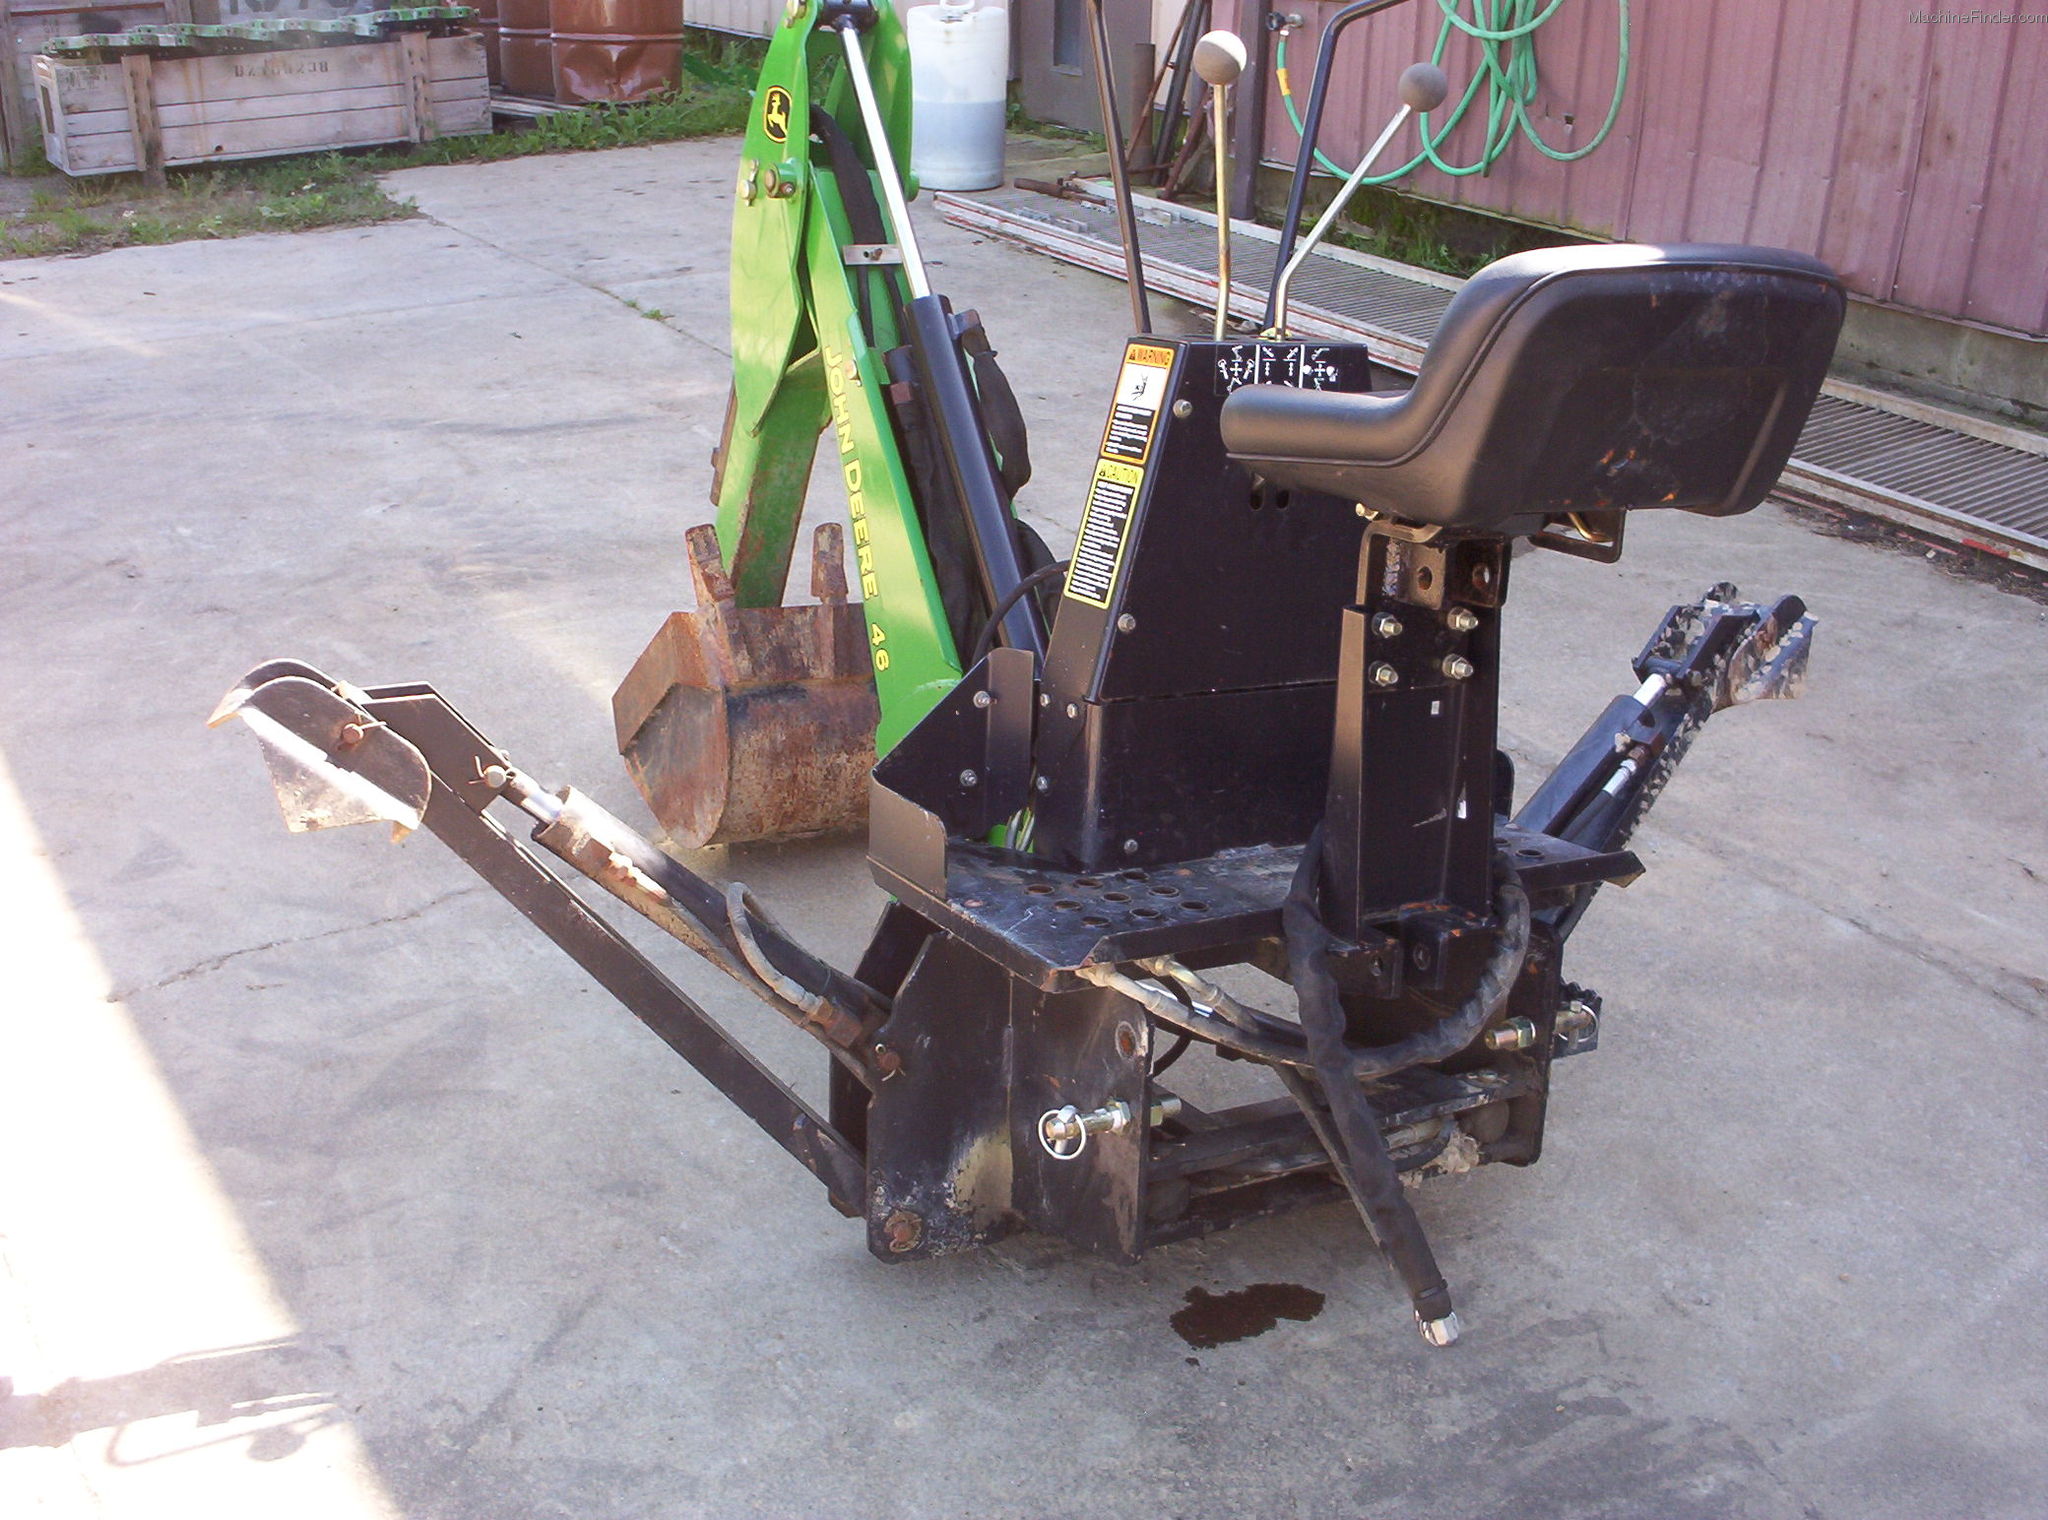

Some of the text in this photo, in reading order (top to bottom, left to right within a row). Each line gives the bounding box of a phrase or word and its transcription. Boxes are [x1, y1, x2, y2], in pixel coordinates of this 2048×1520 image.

[1136, 348, 1172, 366] WARNING
[1105, 464, 1139, 485] CAUTION
[824, 344, 890, 672] JOHN DEERE 46
